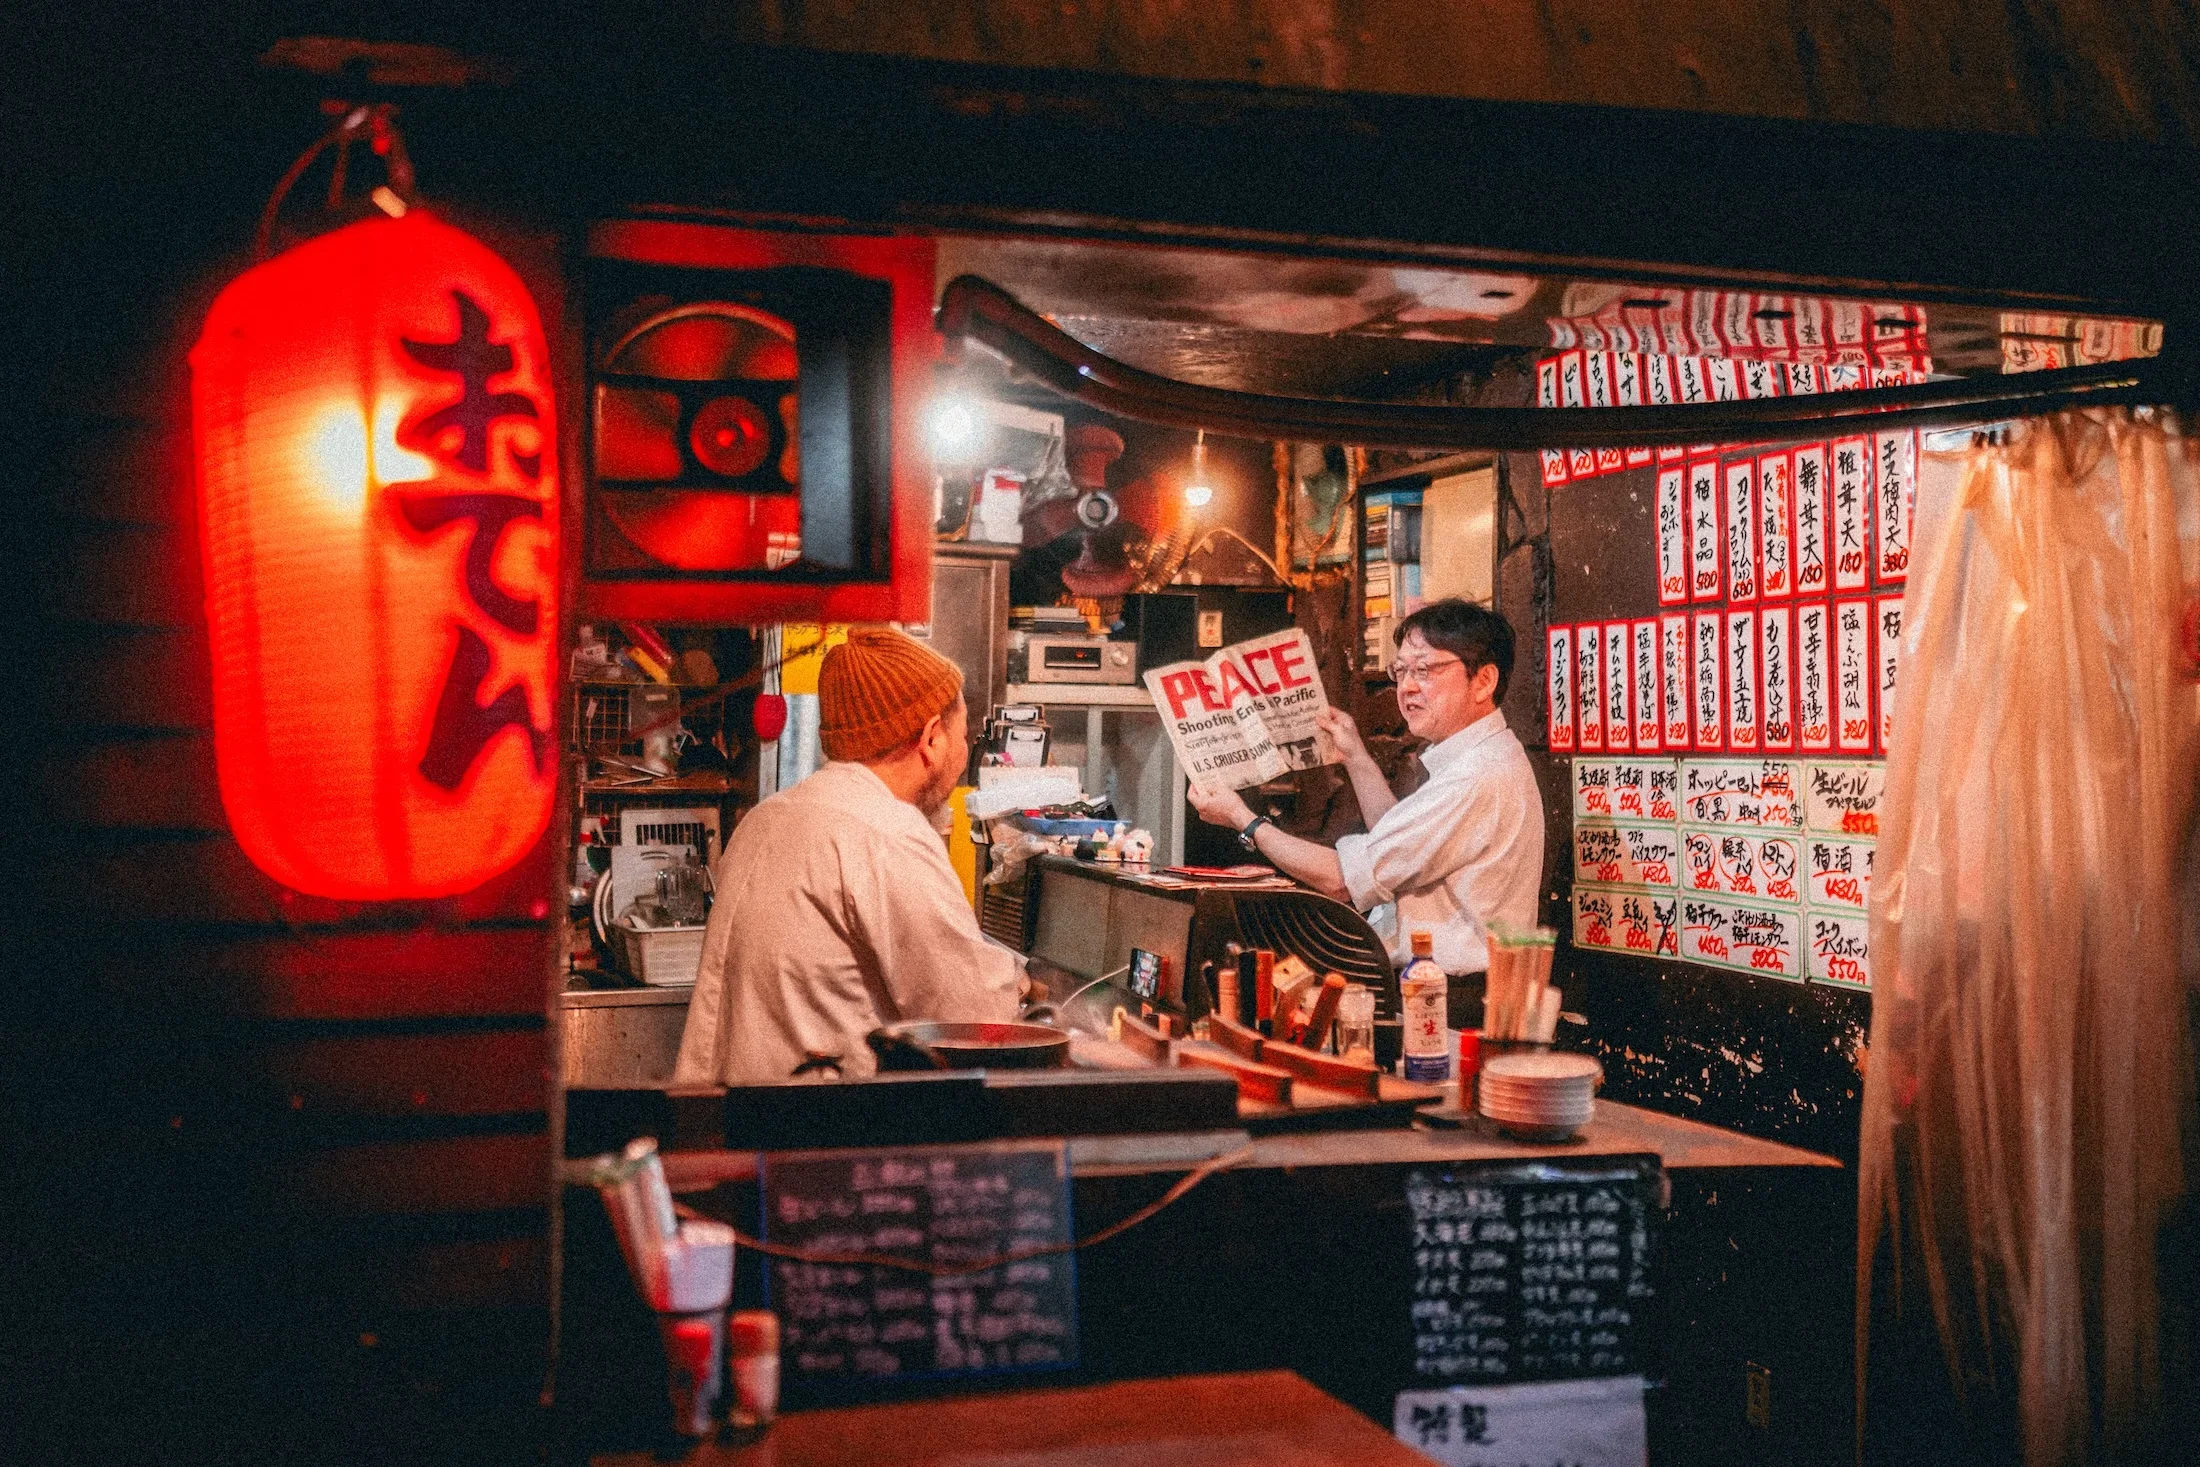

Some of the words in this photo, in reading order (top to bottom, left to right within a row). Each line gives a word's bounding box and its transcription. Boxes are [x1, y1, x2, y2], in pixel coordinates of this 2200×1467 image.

[1798, 457, 1823, 566] 舞茸天
[1837, 450, 1860, 548] 椎茸天
[1799, 564, 1823, 586] 180
[1838, 551, 1862, 574] 180
[1160, 639, 1313, 721] PEACE
[1554, 637, 1567, 725] アジフライ
[1177, 712, 1237, 735] Shooting
[1236, 698, 1266, 720] Ends
[1272, 687, 1317, 709] Pacific
[1214, 749, 1250, 769] CRUISER
[1249, 738, 1274, 760] SUNK
[1762, 759, 1789, 777] 550
[1810, 767, 1870, 797] 生ビール
[1812, 843, 1852, 874] 梅酒
[1825, 877, 1863, 907] 480円
[1827, 953, 1867, 986] 550円
